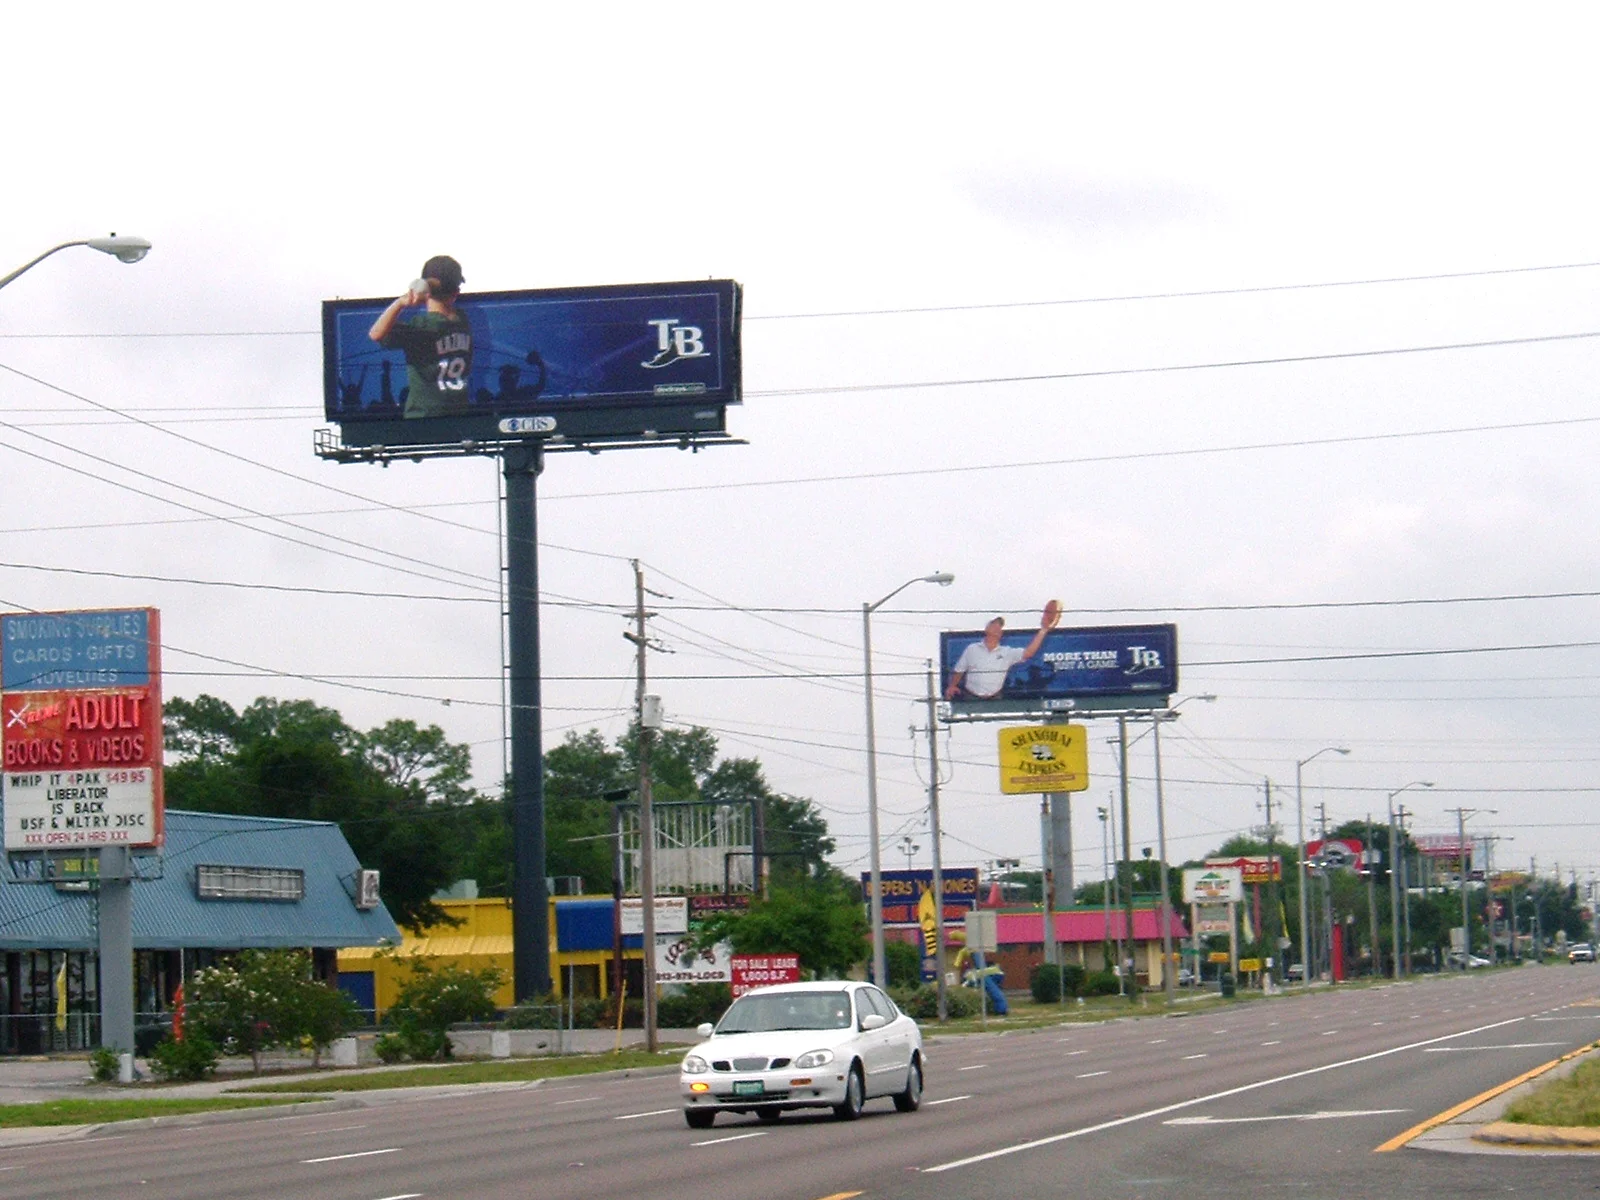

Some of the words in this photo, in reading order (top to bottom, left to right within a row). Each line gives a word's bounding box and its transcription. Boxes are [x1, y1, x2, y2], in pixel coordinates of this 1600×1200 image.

[643, 319, 709, 364] TB
[438, 358, 465, 390] 19
[7, 618, 72, 641] SMOKING
[12, 647, 73, 663] CARDS
[86, 644, 136, 661] GIFTS
[1043, 652, 1081, 662] MORE
[1083, 651, 1118, 661] THAN
[30, 668, 118, 685] NOVELTIES
[66, 693, 145, 731] ADULT
[6, 738, 63, 765] BOOKS
[70, 738, 78, 763] &
[87, 735, 145, 761] VIDEOS
[11, 774, 42, 787] WHIP
[50, 773, 61, 785] IT
[67, 773, 101, 786] 4PAK
[47, 787, 108, 801] LIBERATOR
[52, 803, 63, 815] IS
[74, 802, 104, 814] BACK
[21, 817, 45, 830] USF
[51, 817, 58, 829] &
[66, 815, 110, 829] MLTRY
[25, 834, 42, 844] XXX
[46, 833, 71, 844] OPEN
[74, 833, 84, 843] 24
[89, 832, 107, 842] HRS
[111, 830, 128, 840] XXX
